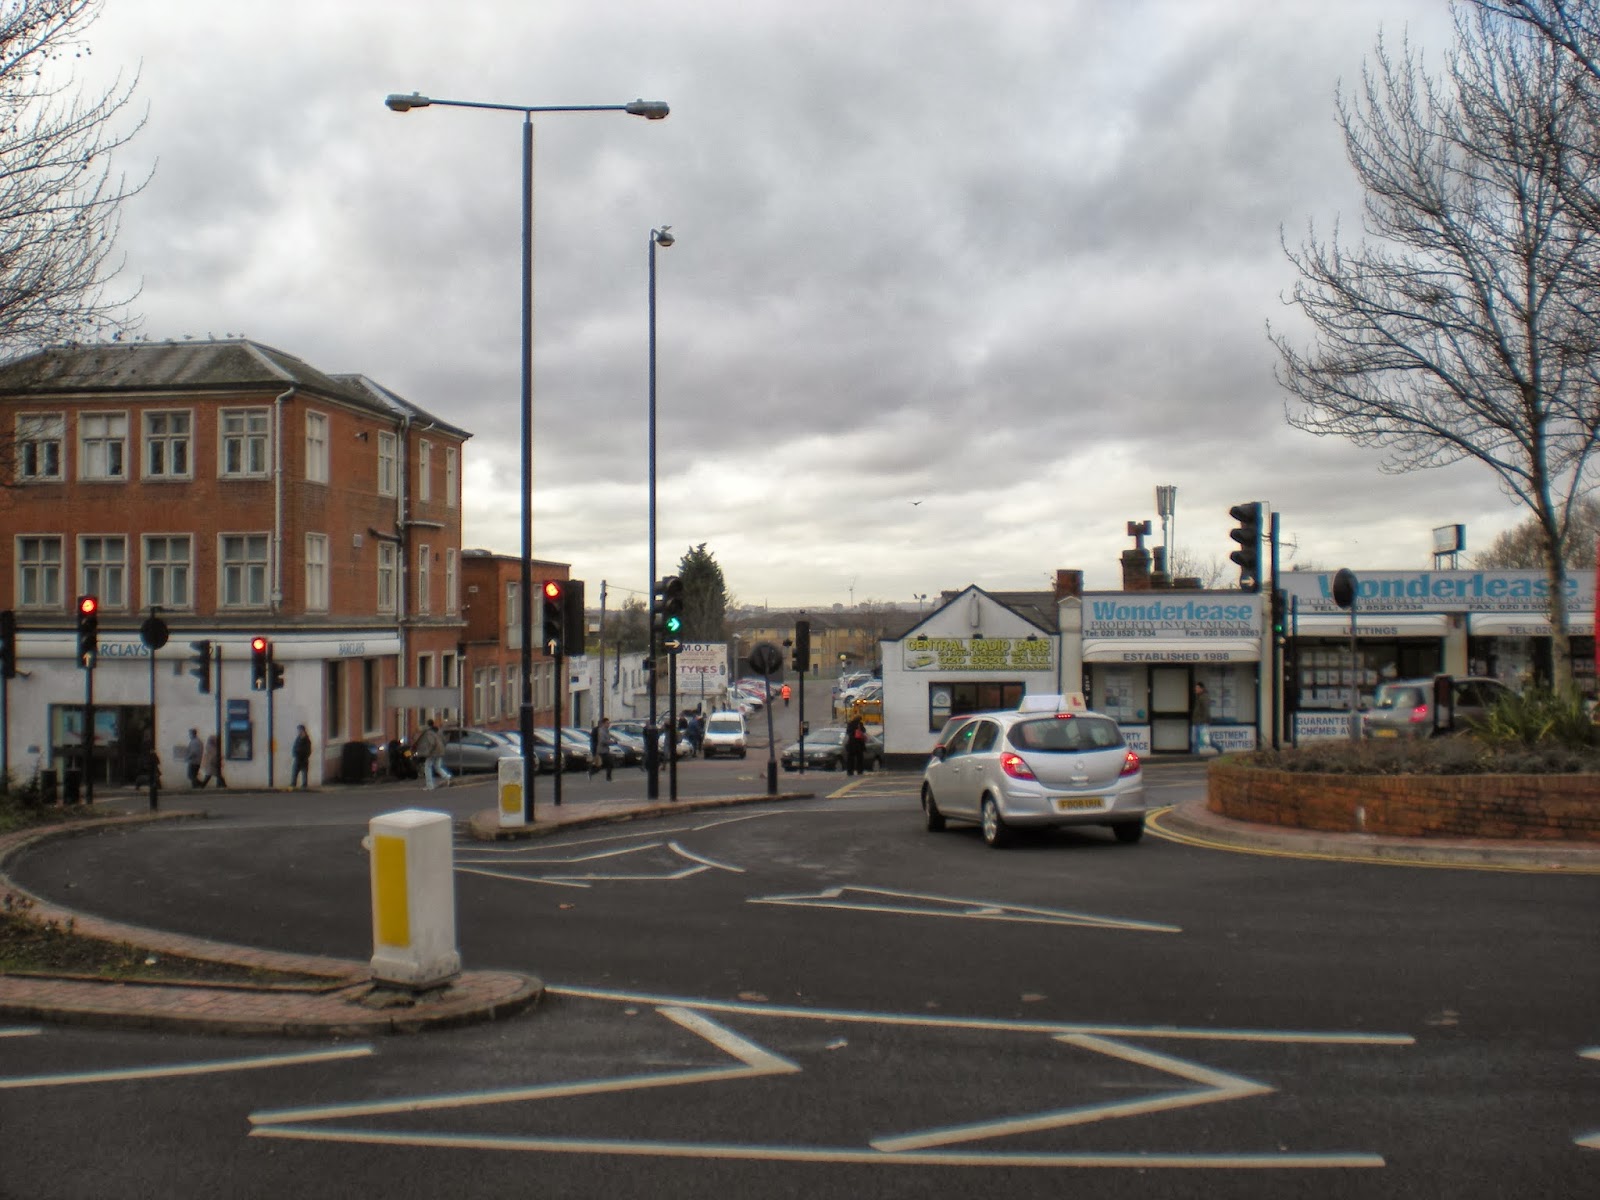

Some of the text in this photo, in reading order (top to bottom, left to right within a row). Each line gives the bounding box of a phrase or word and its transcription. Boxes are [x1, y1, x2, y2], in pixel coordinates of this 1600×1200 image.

[1092, 601, 1253, 621] Wonderlease
[1091, 621, 1155, 630] PROPERTY
[97, 643, 149, 657] RCLAYS
[907, 639, 1051, 651] CENTRAL RADIO CARS
[1123, 653, 1230, 661] ESTABLISHED 1988
[1072, 696, 1081, 706] L
